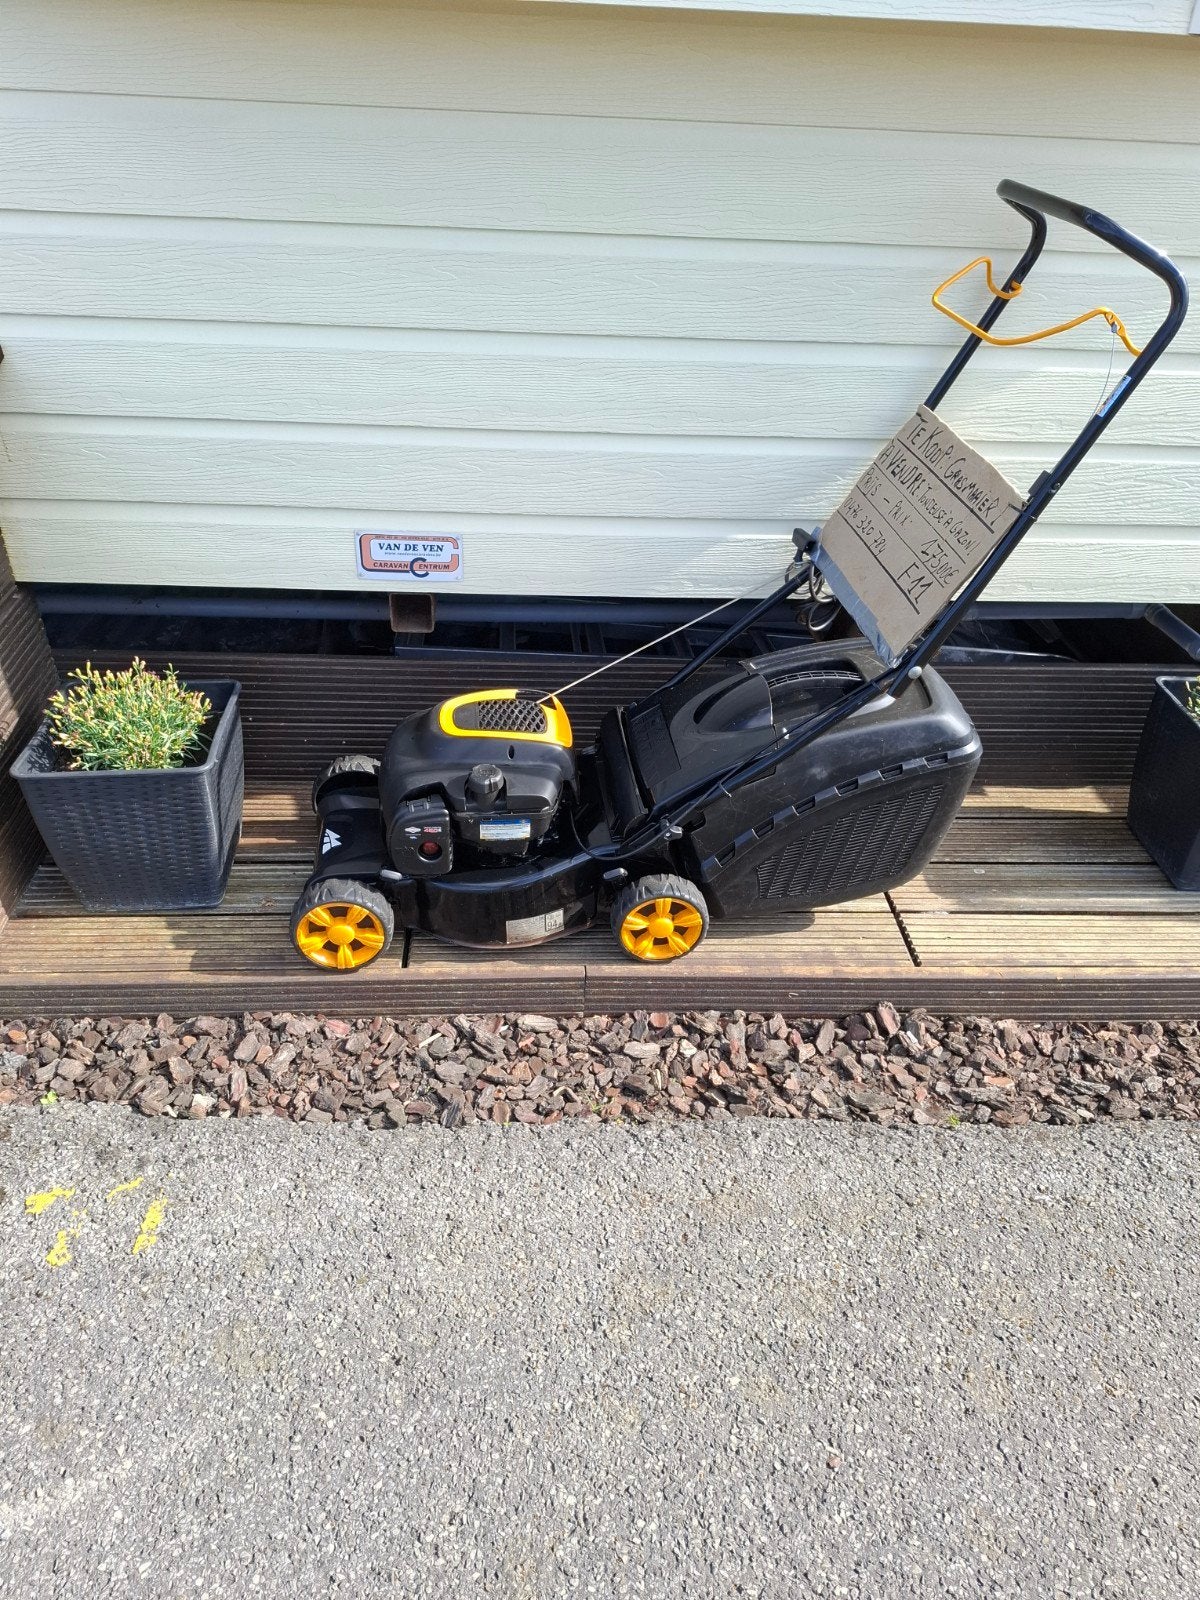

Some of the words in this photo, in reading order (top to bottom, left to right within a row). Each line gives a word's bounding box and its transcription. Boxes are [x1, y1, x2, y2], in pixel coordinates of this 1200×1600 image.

[907, 417, 928, 445] TE
[918, 426, 954, 470] KOOP:
[373, 561, 409, 569] CARAVAN
[378, 542, 401, 551] VAN
[404, 543, 419, 552] DE
[422, 544, 444, 553] VEN
[843, 497, 863, 519] 0476
[897, 561, 934, 604] F11
[920, 538, 960, 585] 175,00€
